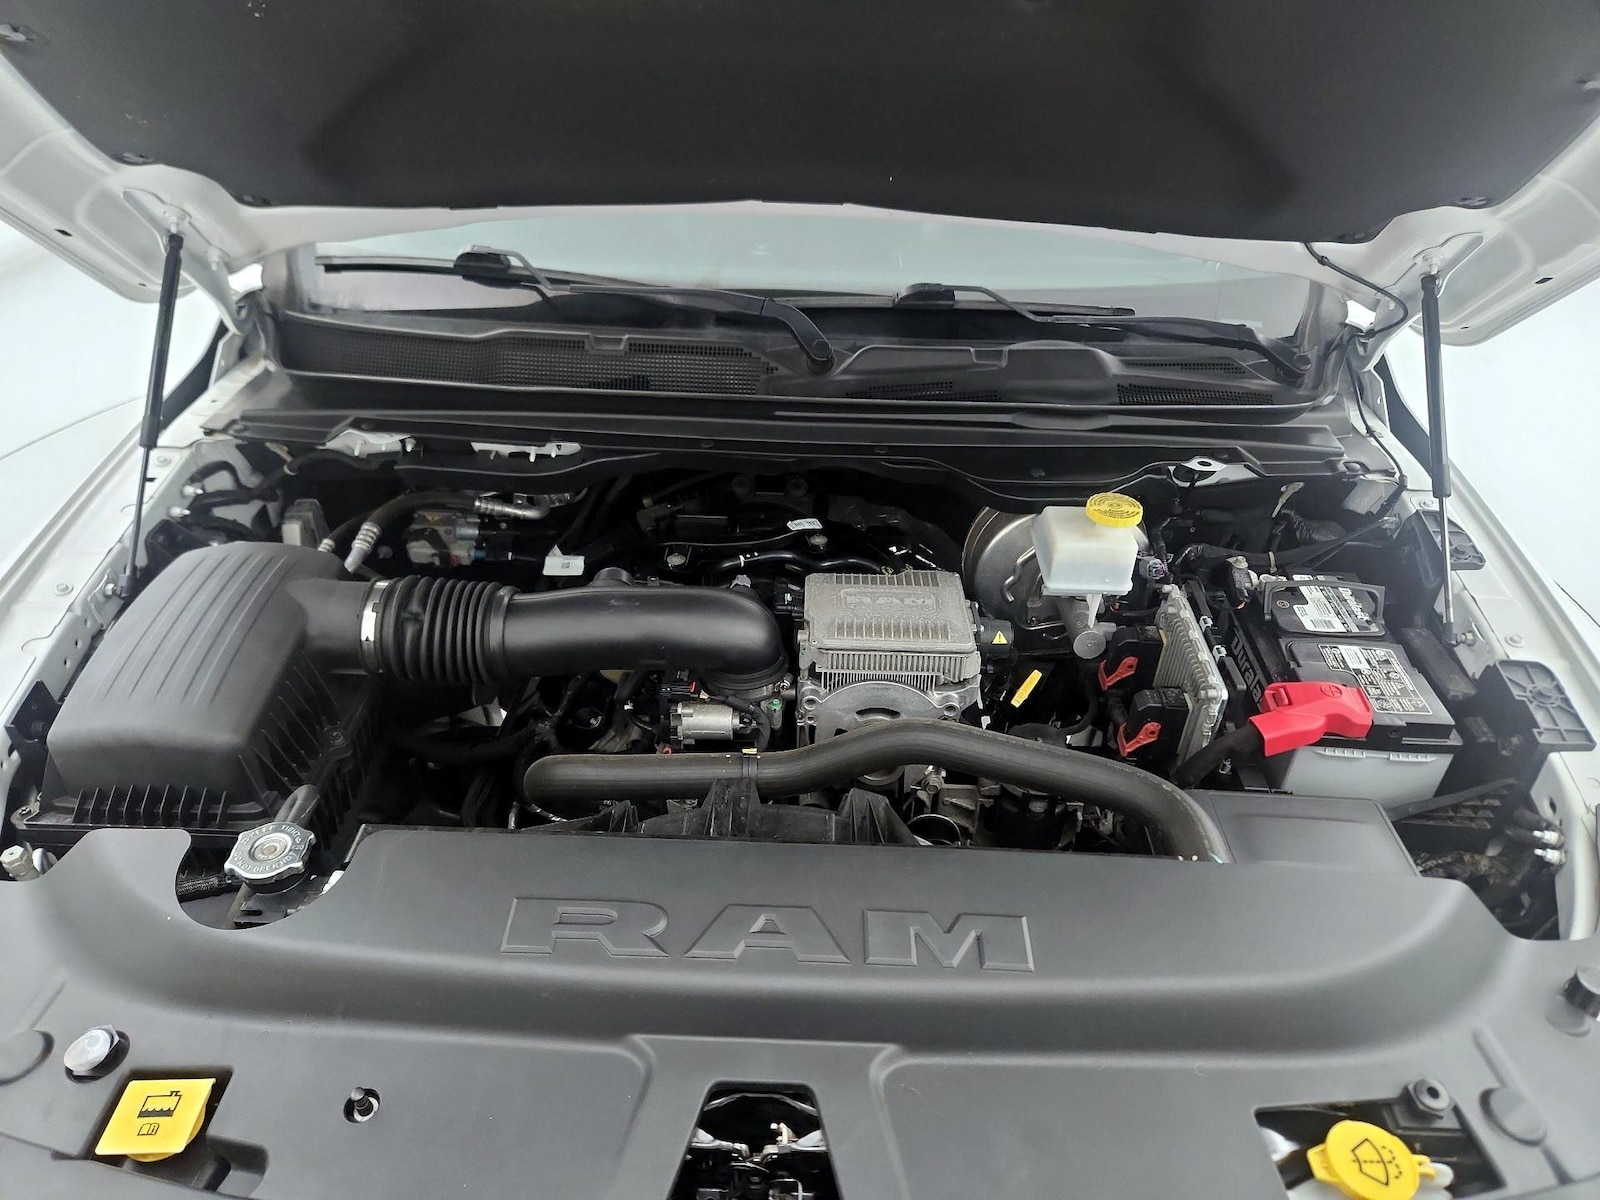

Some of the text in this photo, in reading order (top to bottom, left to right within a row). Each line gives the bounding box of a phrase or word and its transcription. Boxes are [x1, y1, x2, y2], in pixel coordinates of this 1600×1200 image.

[1337, 587, 1371, 623] Duralast
[1230, 628, 1263, 702] Durala
[499, 896, 1035, 972] RAM
